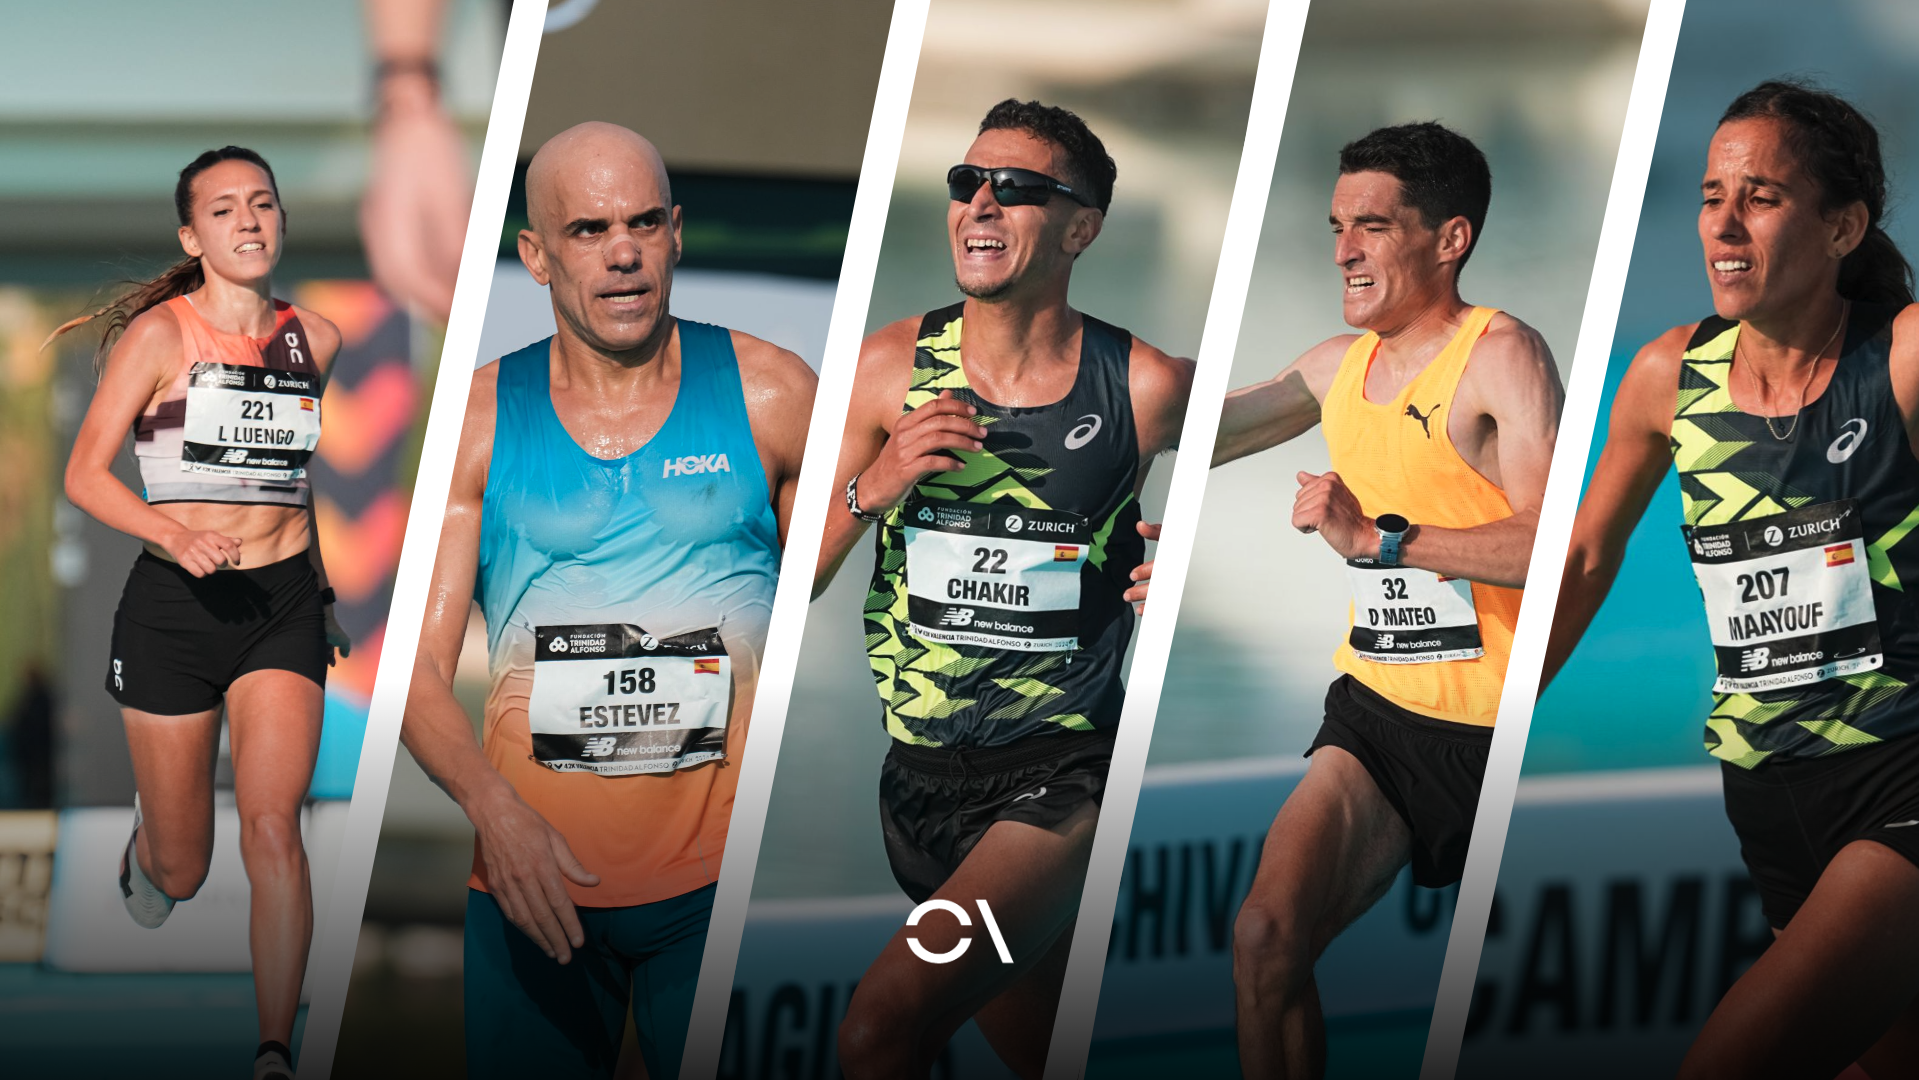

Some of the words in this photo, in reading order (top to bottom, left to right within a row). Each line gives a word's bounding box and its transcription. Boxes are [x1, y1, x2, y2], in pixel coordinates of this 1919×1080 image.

[278, 379, 309, 390] ZURICH
[241, 400, 273, 421] 221
[218, 426, 227, 442] L
[233, 426, 295, 446] LUENGO
[262, 458, 289, 467] balance
[662, 453, 731, 479] HOKA
[936, 511, 972, 522] TRINIDAD
[937, 506, 972, 515] FUNDACIÓN
[935, 519, 971, 529] ALFONSO
[1028, 520, 1075, 534] ZURICH
[1788, 517, 1841, 539] ZURICH
[1702, 541, 1731, 550] TRINIDAD
[972, 547, 1008, 574] 22
[947, 578, 1030, 607] CHAKIR
[1382, 577, 1409, 600] 32
[1736, 566, 1790, 604] 207
[1368, 608, 1379, 626] D
[1382, 607, 1437, 626] MATEO
[1728, 601, 1824, 641] MAAYOUF
[974, 619, 991, 630] new
[994, 621, 1034, 634] balance
[570, 639, 606, 647] TRINIDAD
[570, 645, 606, 654] ALFONSO
[1409, 640, 1441, 649] balance
[1771, 655, 1789, 668] new
[1789, 651, 1824, 665] balance
[603, 667, 656, 695] 158
[579, 702, 681, 728] ESTEVEZ
[616, 747, 638, 756] new
[639, 744, 682, 755] balance
